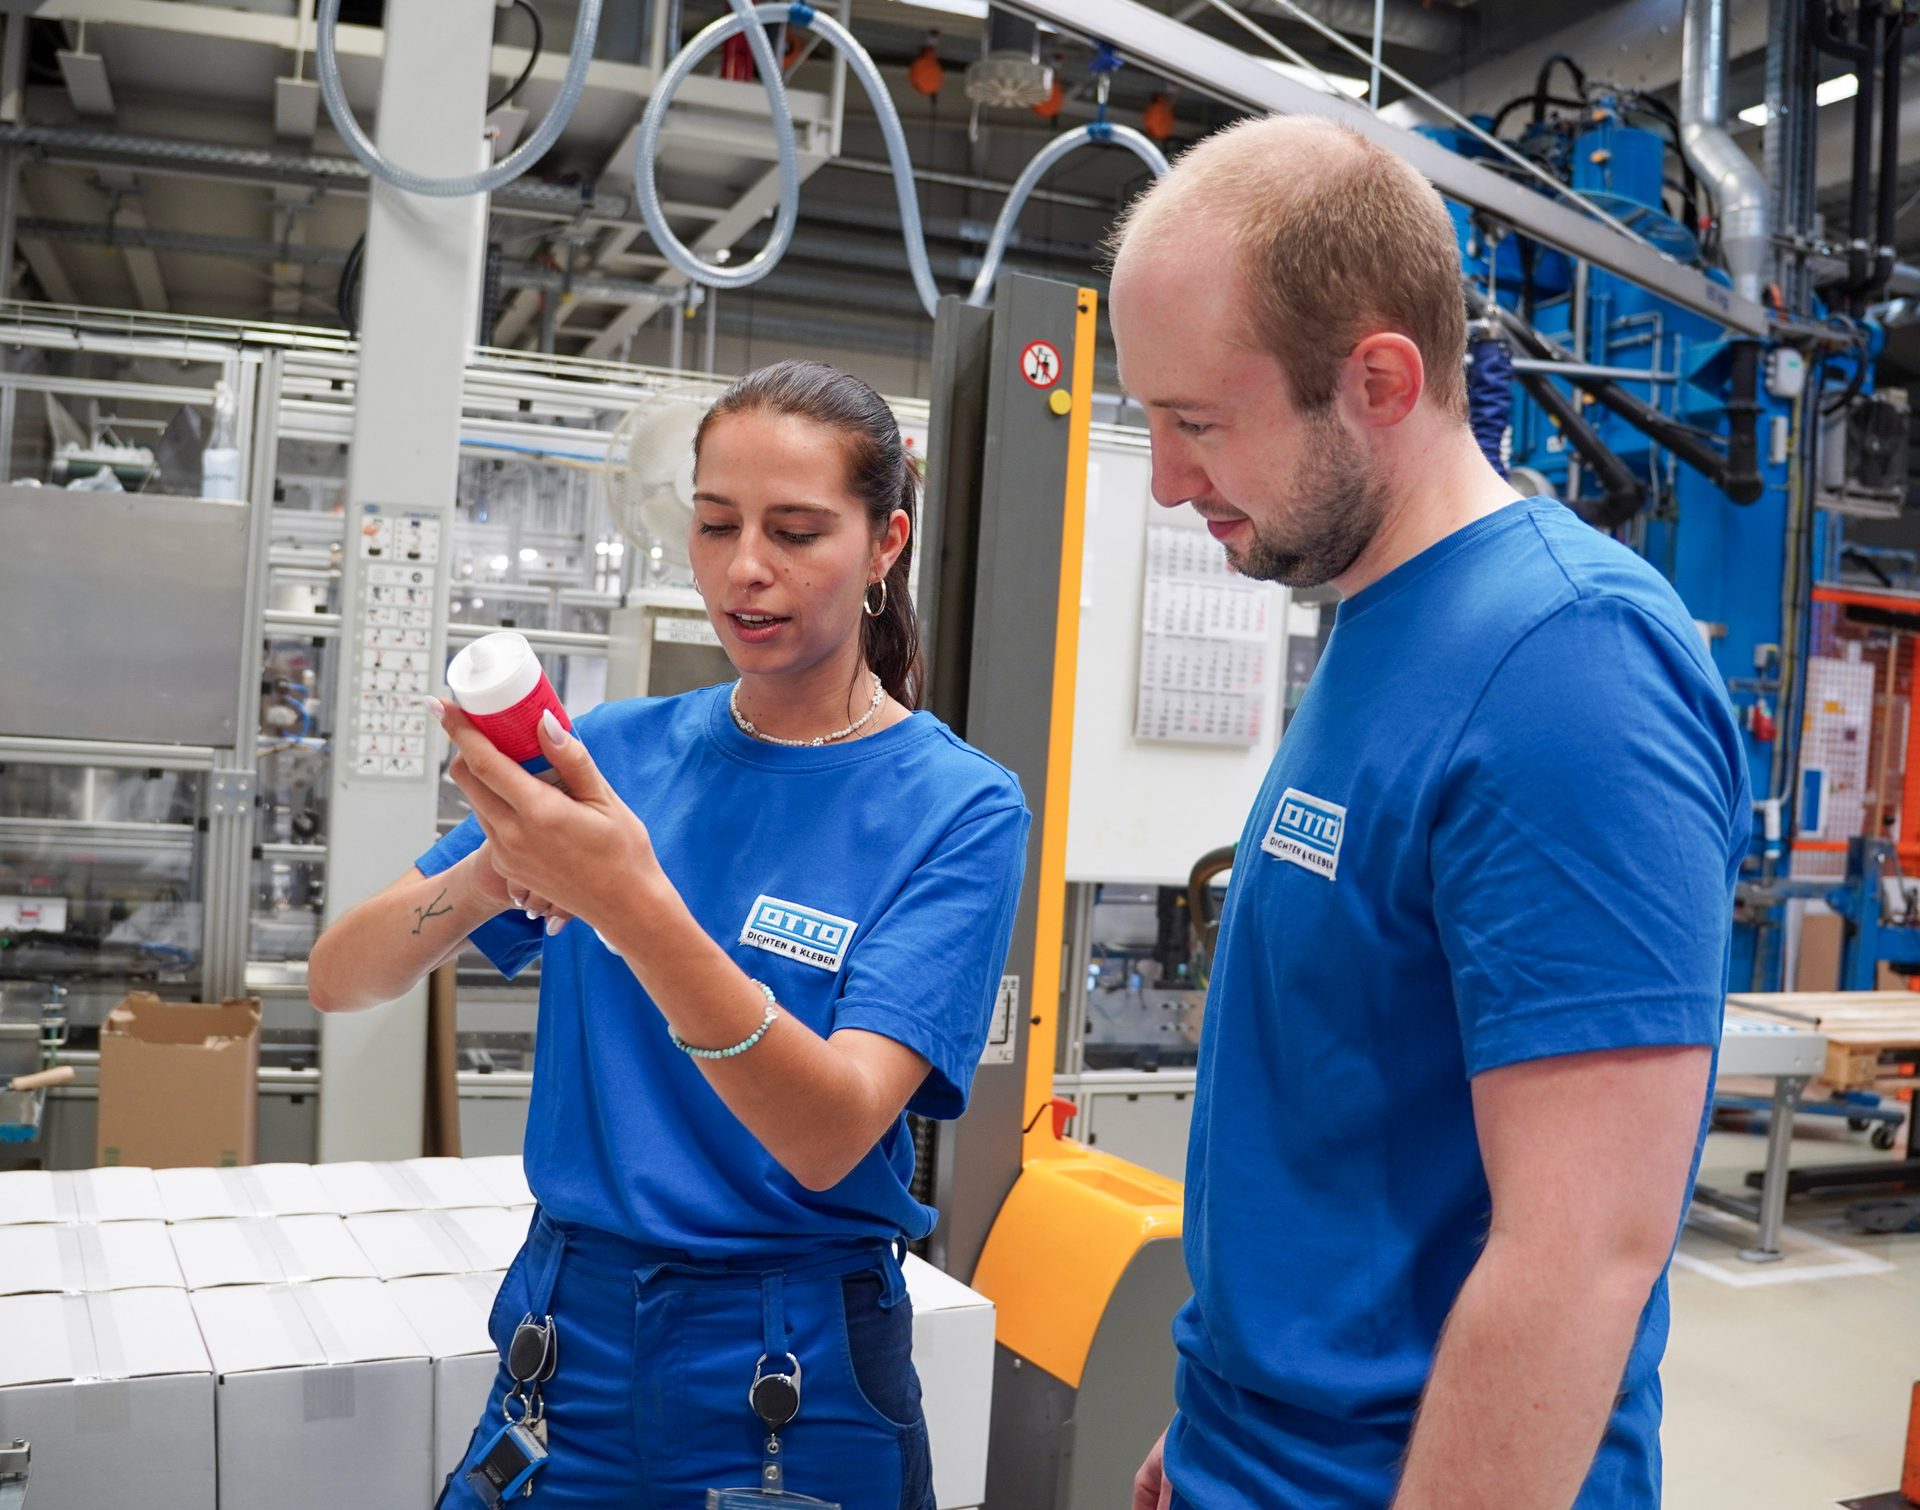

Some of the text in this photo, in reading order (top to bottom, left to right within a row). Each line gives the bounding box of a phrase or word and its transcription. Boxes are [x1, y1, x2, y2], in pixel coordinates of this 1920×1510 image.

[1281, 802, 1340, 844] OTTO
[1269, 836, 1302, 855] DICHTEN
[759, 906, 844, 945] OTTO
[747, 931, 836, 966] DICHTEN & KLEBEN
